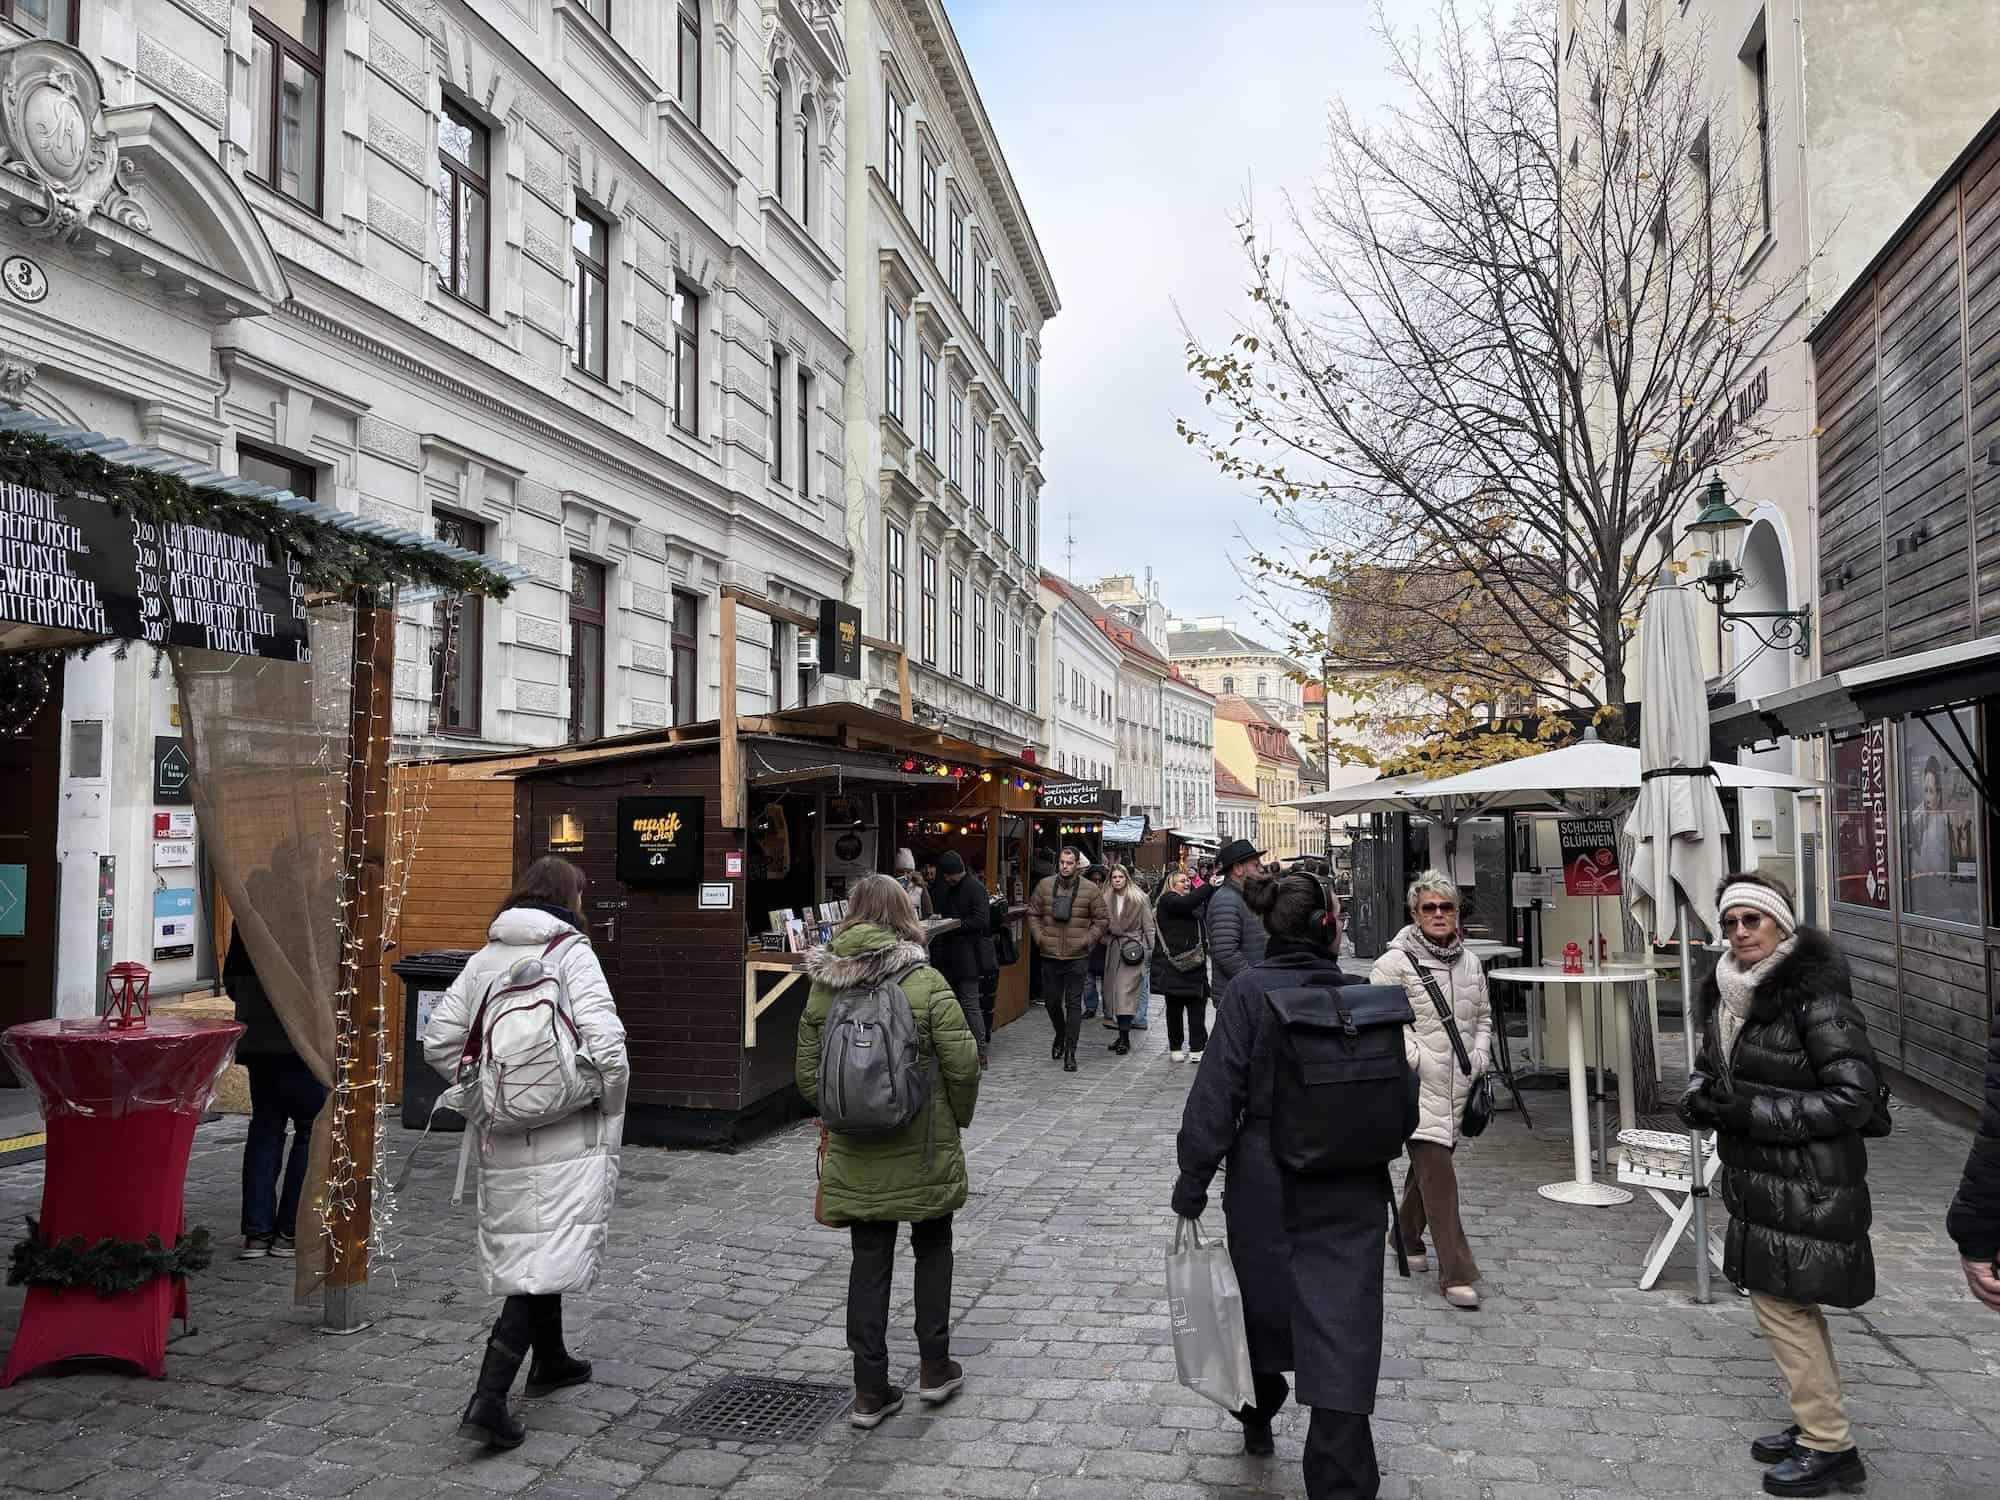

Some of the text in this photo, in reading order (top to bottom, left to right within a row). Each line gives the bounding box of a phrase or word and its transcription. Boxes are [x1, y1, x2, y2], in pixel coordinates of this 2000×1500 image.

[19, 262, 32, 286] 3
[163, 520, 266, 568] CAIPIRINHAPUNSCH
[166, 547, 256, 588] MOJITOPUNSCH
[170, 571, 258, 610] APEROLPUNSCH
[0, 592, 105, 635] ITTENPUNSCH
[172, 596, 276, 637] WILDBERRY LILLET
[206, 626, 255, 655] PUNSCH
[1044, 793, 1098, 806] PUNSCH
[1871, 724, 1888, 902] Klavierhaus
[633, 811, 682, 832] musik
[640, 831, 653, 841] ab
[1560, 820, 1613, 834] SCHILCHER
[1562, 832, 1615, 848] GLÜHWEIN
